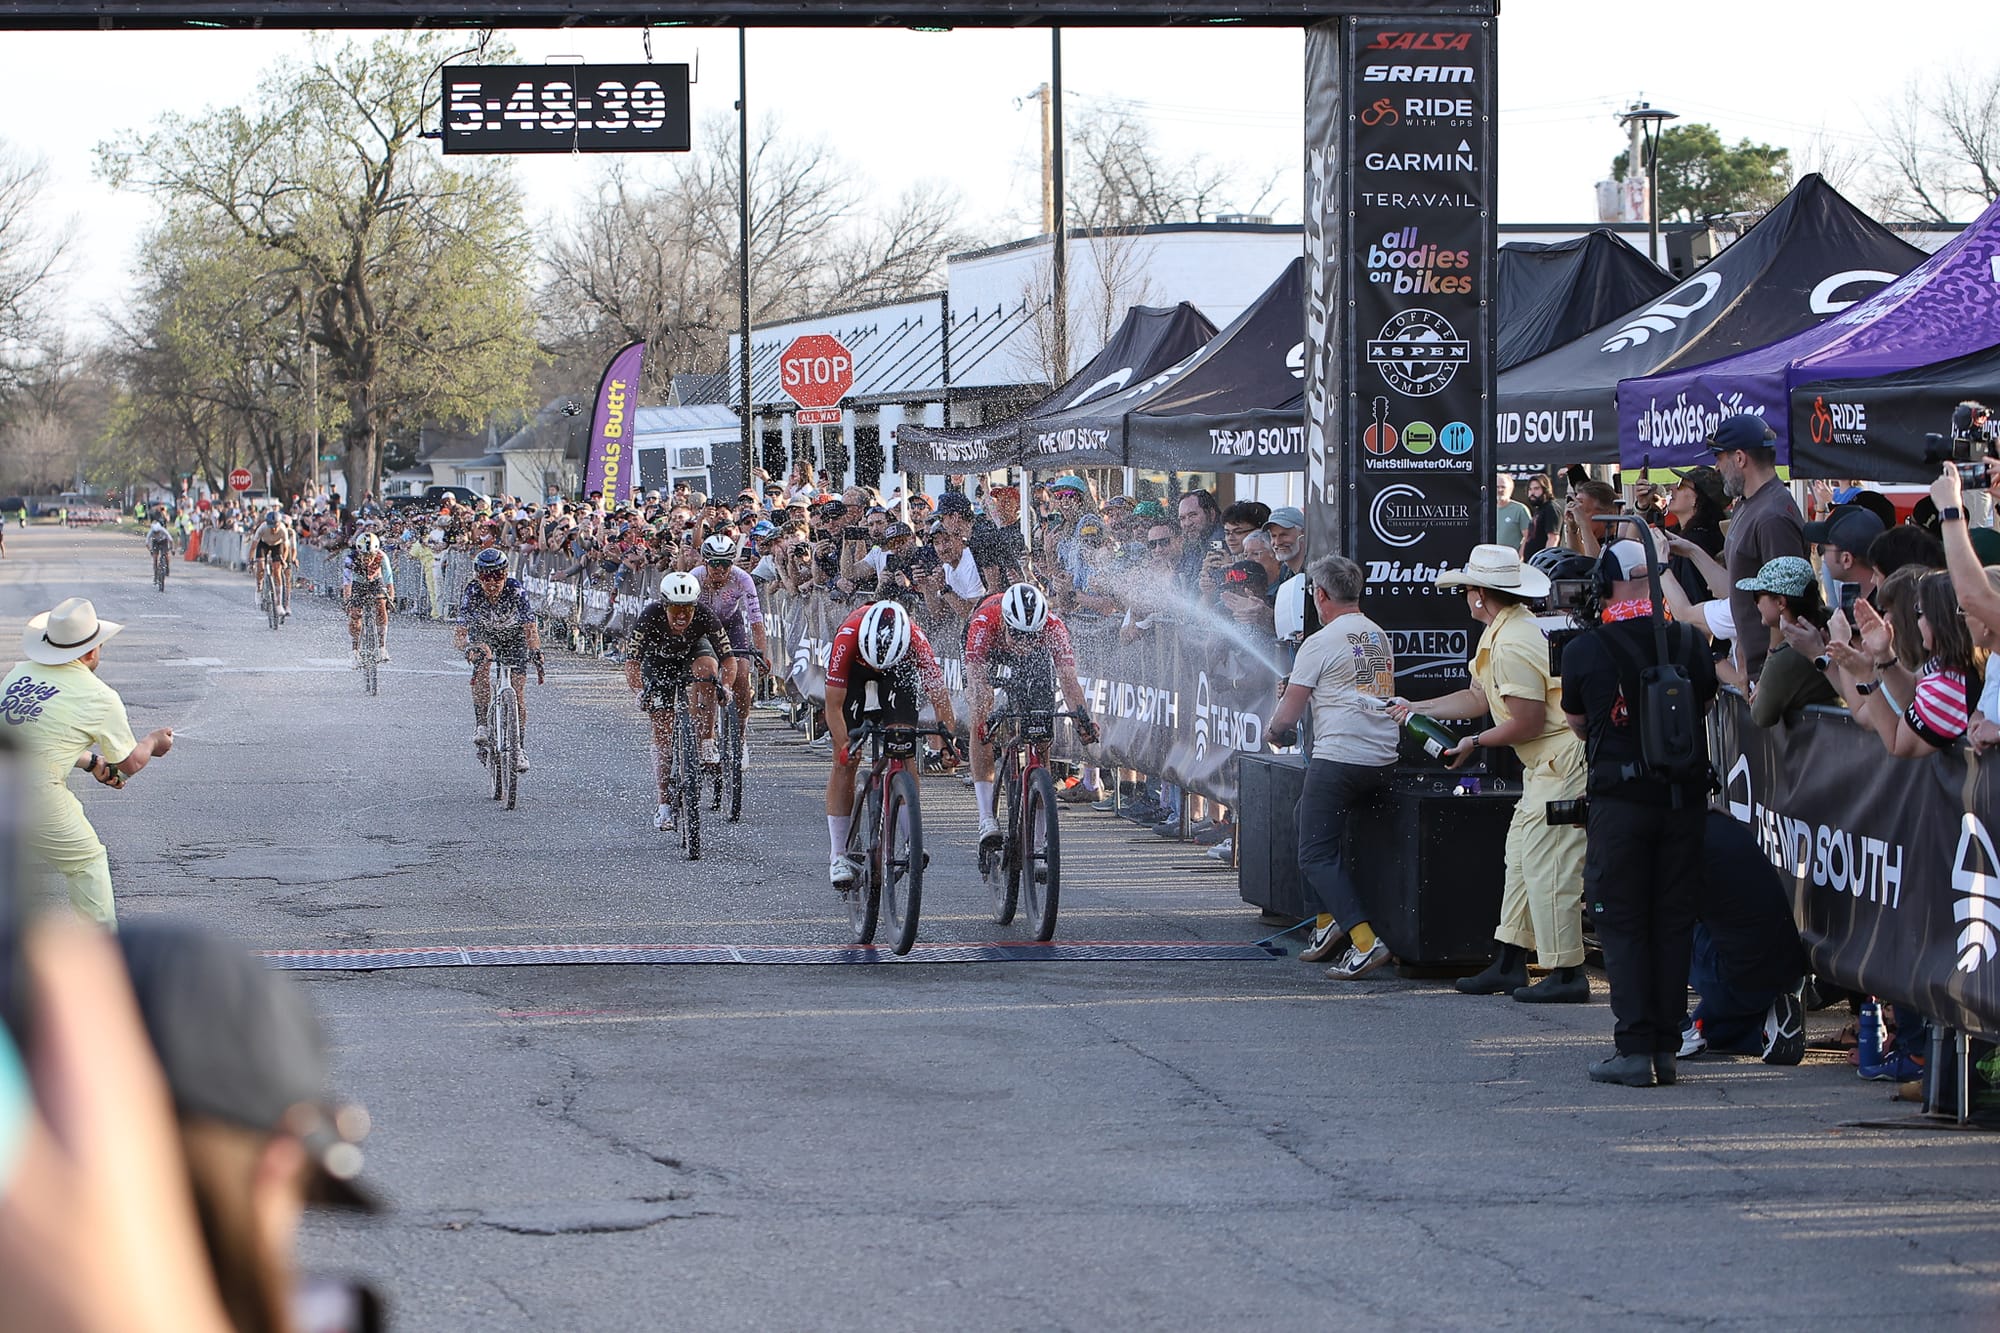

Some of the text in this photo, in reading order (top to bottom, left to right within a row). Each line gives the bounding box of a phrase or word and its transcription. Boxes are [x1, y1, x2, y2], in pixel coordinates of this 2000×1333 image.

[1367, 32, 1472, 50] SALSA
[1364, 65, 1474, 83] SRAM
[449, 81, 666, 131] 5:48:39
[1405, 98, 1473, 117] RIDE
[1405, 119, 1473, 128] WITH GPS
[1365, 152, 1474, 172] GARMIN
[1361, 193, 1476, 209] TERAVAIL
[1382, 226, 1418, 249] all
[1367, 244, 1470, 269] bodies
[1369, 269, 1472, 294] on bikes
[1384, 311, 1453, 339] COFFEE
[1371, 346, 1466, 356] ASPEN
[785, 356, 849, 386] STOP
[1382, 363, 1454, 394] COMPANY
[801, 412, 837, 422] ALL WAY
[1524, 409, 1594, 443] SOUTH
[1637, 410, 1651, 442] all
[1651, 392, 1704, 448] bodies
[1829, 403, 1868, 431] RIDE
[929, 441, 946, 461] THE
[960, 438, 989, 461] SOUTH
[1038, 428, 1111, 454] THE MID SOUTH
[1209, 429, 1233, 455] THE
[1233, 430, 1255, 457] MID
[1832, 433, 1867, 445] WITH GPS
[1365, 458, 1473, 471] VisitStillwaterOK.org
[230, 475, 251, 486] STOP
[1385, 501, 1469, 519] STILLWATER
[1365, 560, 1470, 583] Distri
[1443, 667, 1468, 678] U.S.A.
[6, 676, 61, 701] Enjoy
[0, 694, 44, 726] Ride
[1108, 681, 1136, 719] MID
[1136, 685, 1179, 729] SOUTH
[1210, 704, 1230, 747] THE
[1755, 802, 1903, 910] THE MID SOUTH
